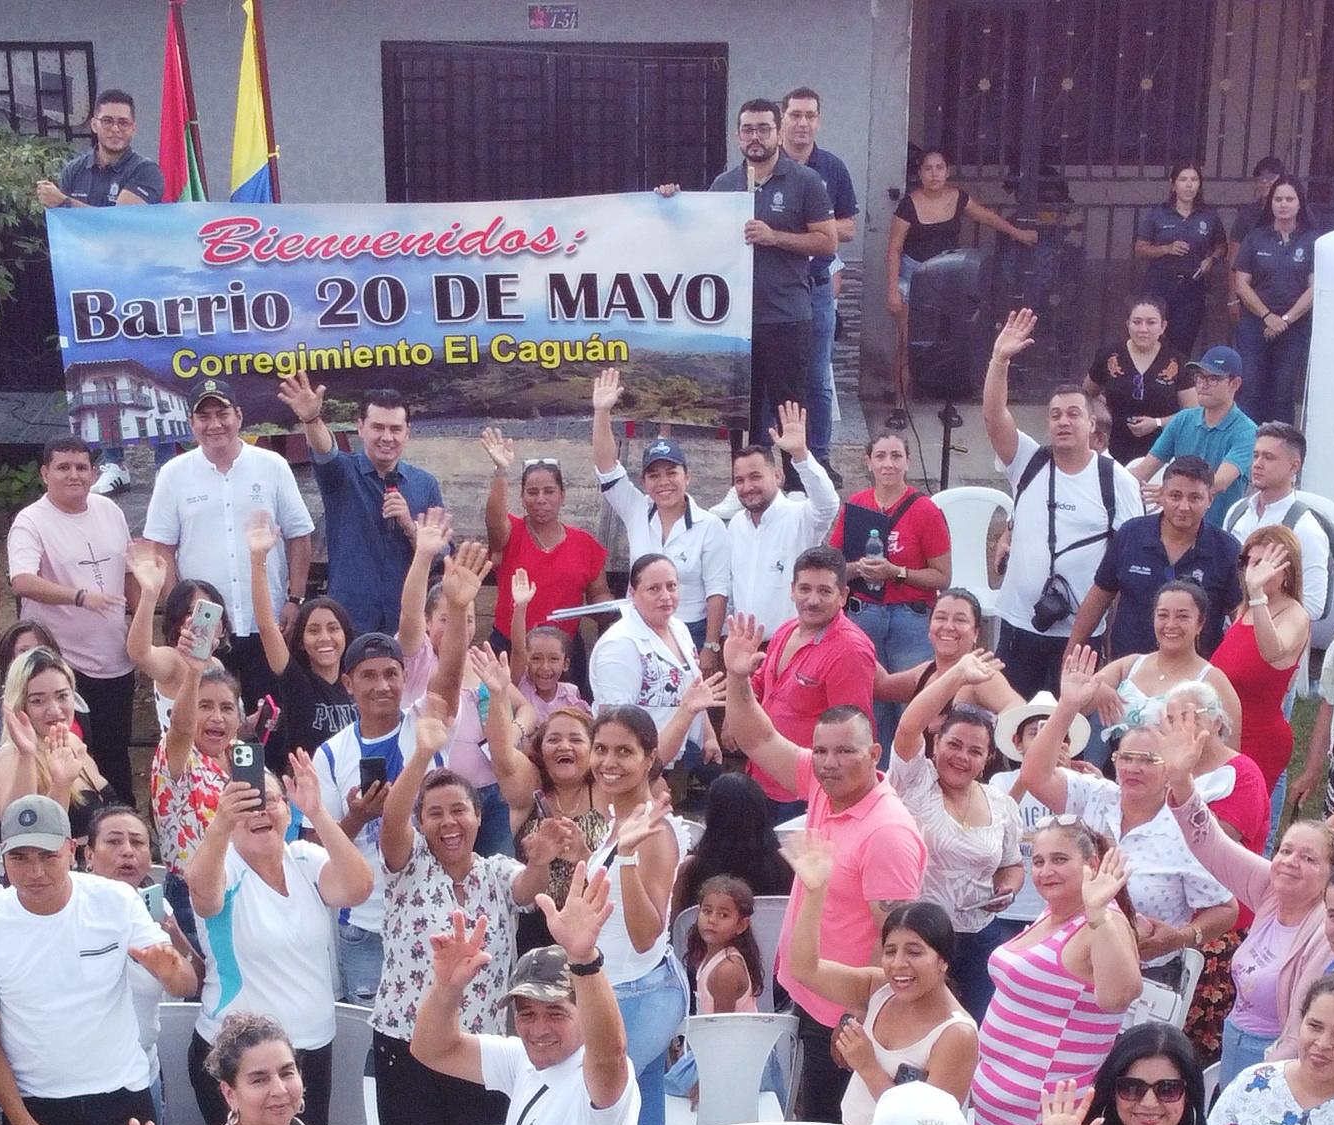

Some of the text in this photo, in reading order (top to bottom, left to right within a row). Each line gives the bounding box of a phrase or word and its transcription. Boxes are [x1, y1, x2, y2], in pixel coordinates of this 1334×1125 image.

[198, 216, 587, 265] Bienvenidos:
[70, 271, 733, 343] Barrio 20 DE MAYO
[171, 333, 629, 379] Corregimiento El Caguán
